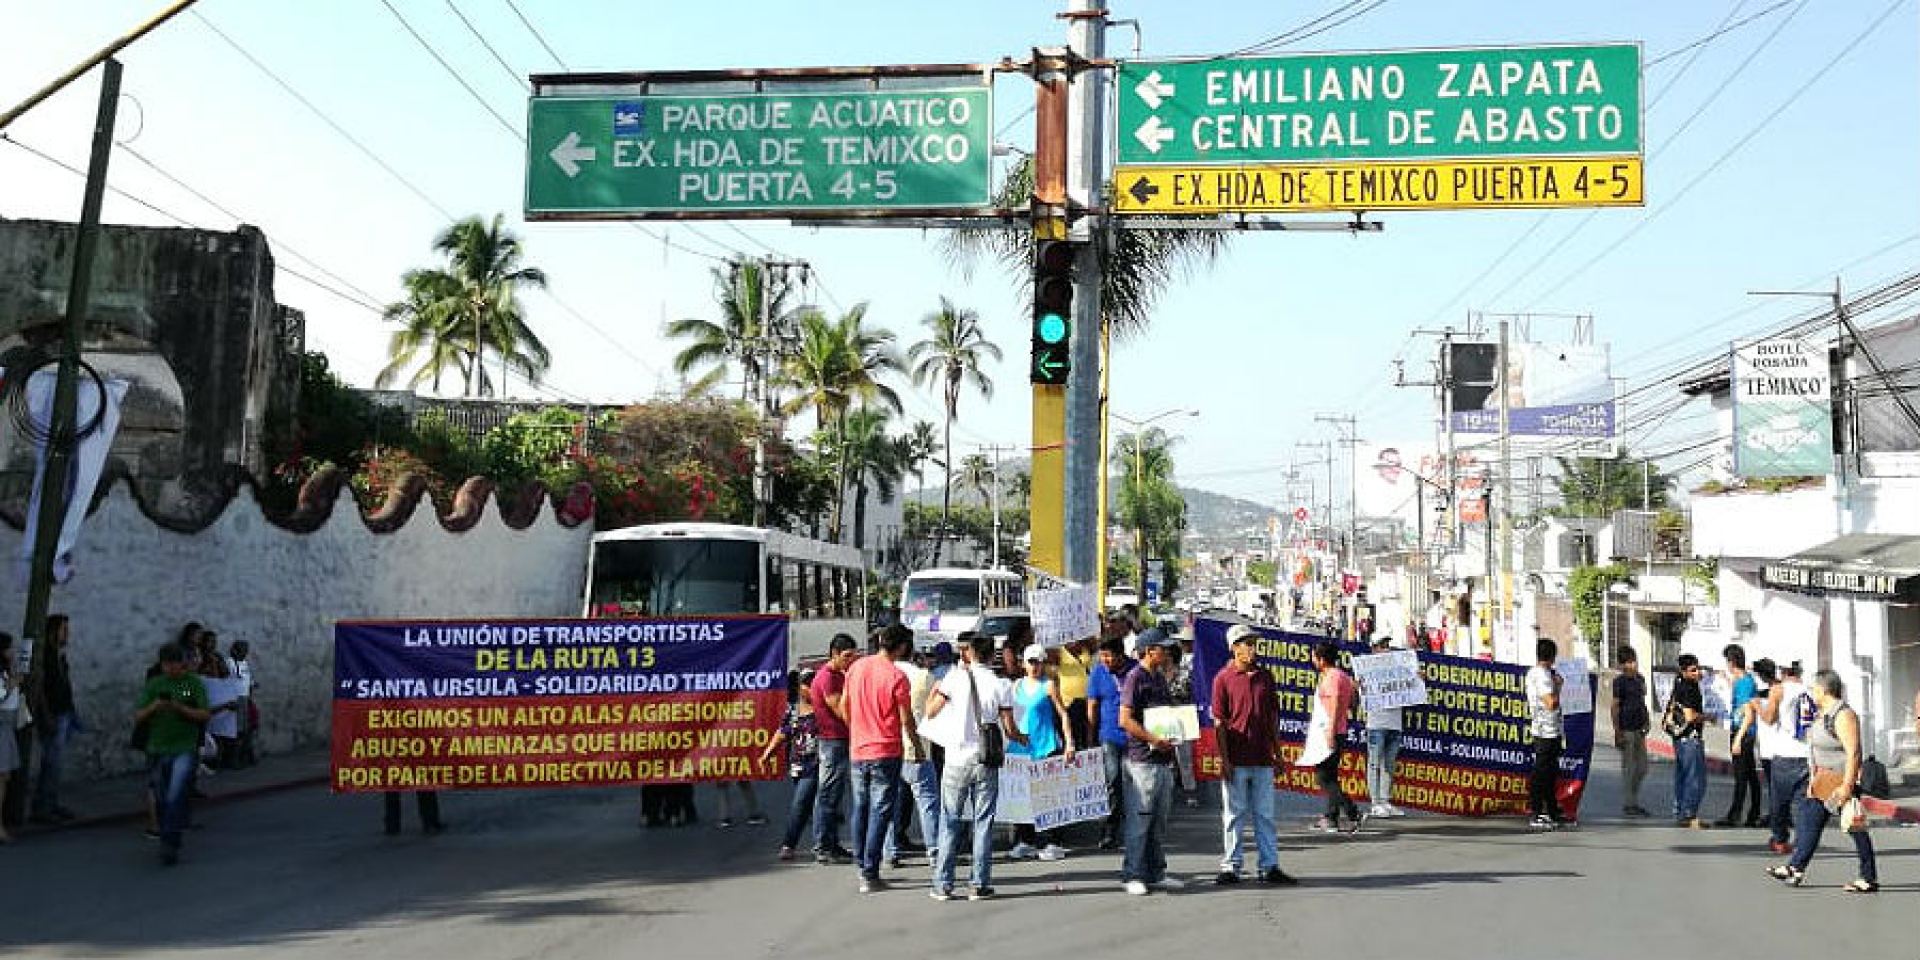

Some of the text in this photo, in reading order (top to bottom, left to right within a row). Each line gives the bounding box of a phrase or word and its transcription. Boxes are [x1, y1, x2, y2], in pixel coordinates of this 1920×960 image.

[1206, 59, 1602, 106] EMILIANO ZAPATA
[662, 98, 972, 133] PARQUE ACUATICO
[1192, 105, 1621, 150] CENTRAL DE ABASTO
[822, 135, 968, 164] TEMIXCO
[679, 171, 897, 202] PUERTA 4-5
[1327, 168, 1438, 204] TEMIXCO
[1452, 166, 1558, 200] PUERTA
[1574, 165, 1630, 197] 4-5
[404, 623, 724, 648] LA UNIÓN DE TRANSPORTISTAS
[476, 647, 656, 671] DE LA RUTA 13
[357, 678, 429, 699] SANTA
[434, 677, 518, 697] URSULA
[534, 673, 678, 695] SOLIDARIDAD
[368, 701, 755, 729] EXIGIMOS UN ALTO ALAS AGRESIONES
[1427, 712, 1449, 733] EN
[1453, 717, 1519, 742] CONTRA
[351, 729, 768, 759] ABUSO Y AMENAZAS QUE HEMOS VIVIDO
[338, 766, 383, 787] POR
[388, 765, 454, 786] PARTE
[459, 764, 487, 783] DE
[492, 763, 518, 782] LA
[525, 761, 633, 782] DIRECTIVA
[638, 759, 664, 777] DE
[669, 758, 695, 776] LA
[699, 756, 752, 775] RUTA
